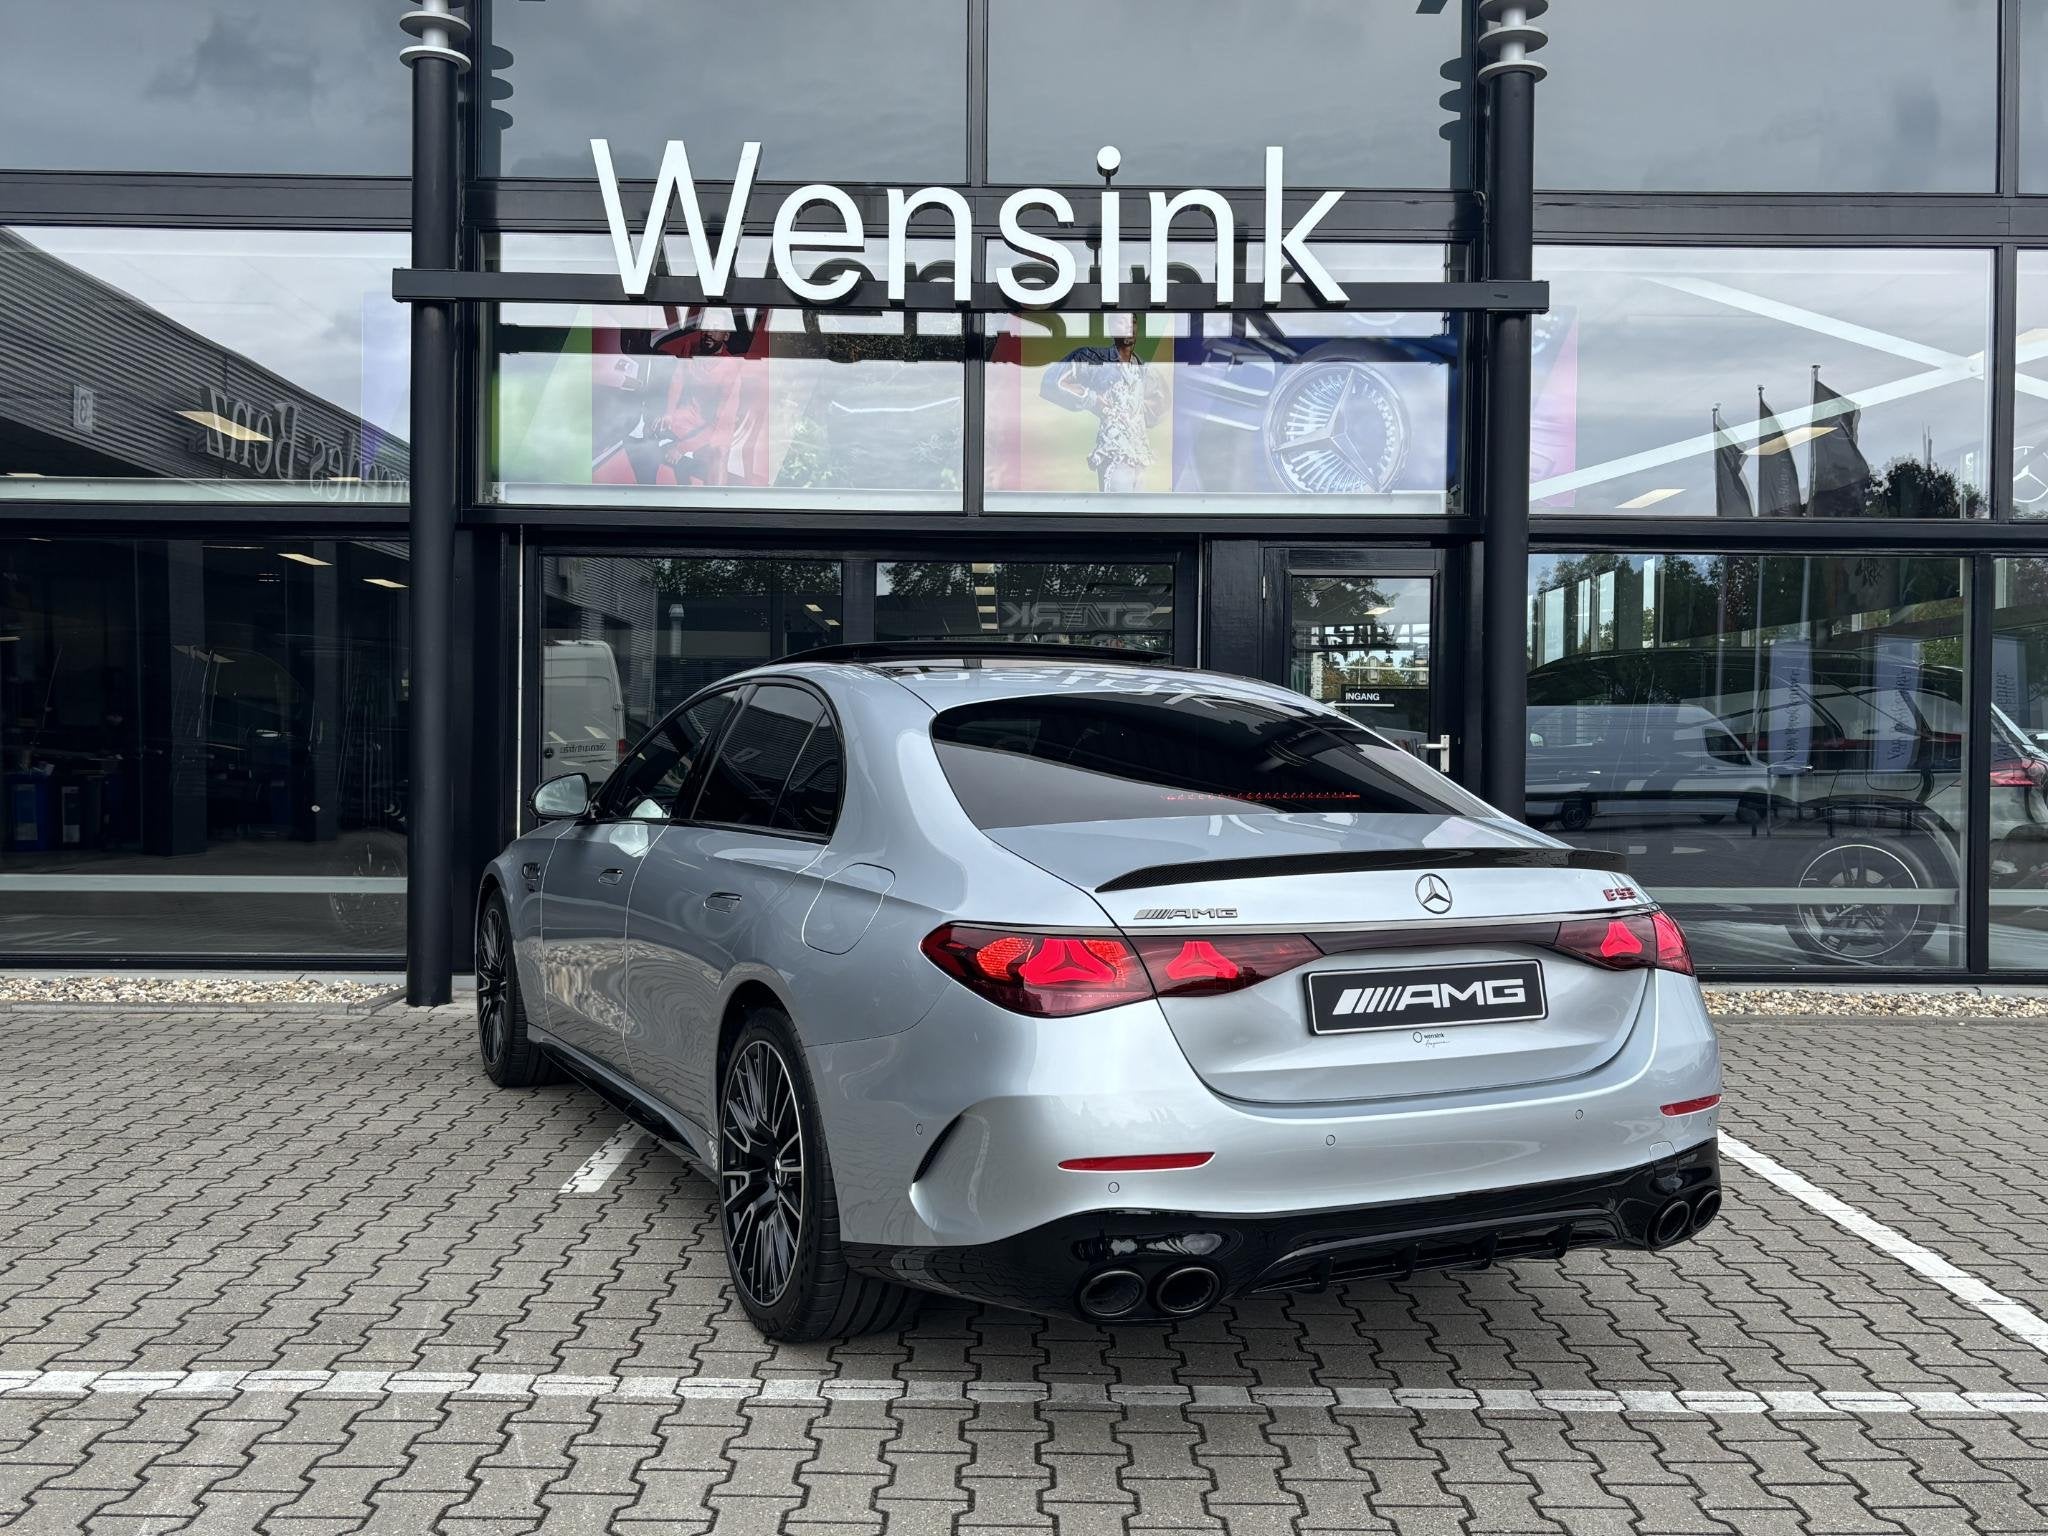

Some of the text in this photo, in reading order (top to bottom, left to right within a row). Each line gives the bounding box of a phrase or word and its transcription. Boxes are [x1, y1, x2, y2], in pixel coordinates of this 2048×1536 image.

[590, 139, 1350, 306] Wensink
[1345, 692, 1380, 701] INGANG
[1602, 887, 1637, 901] E53
[1393, 978, 1526, 1012] AMG
